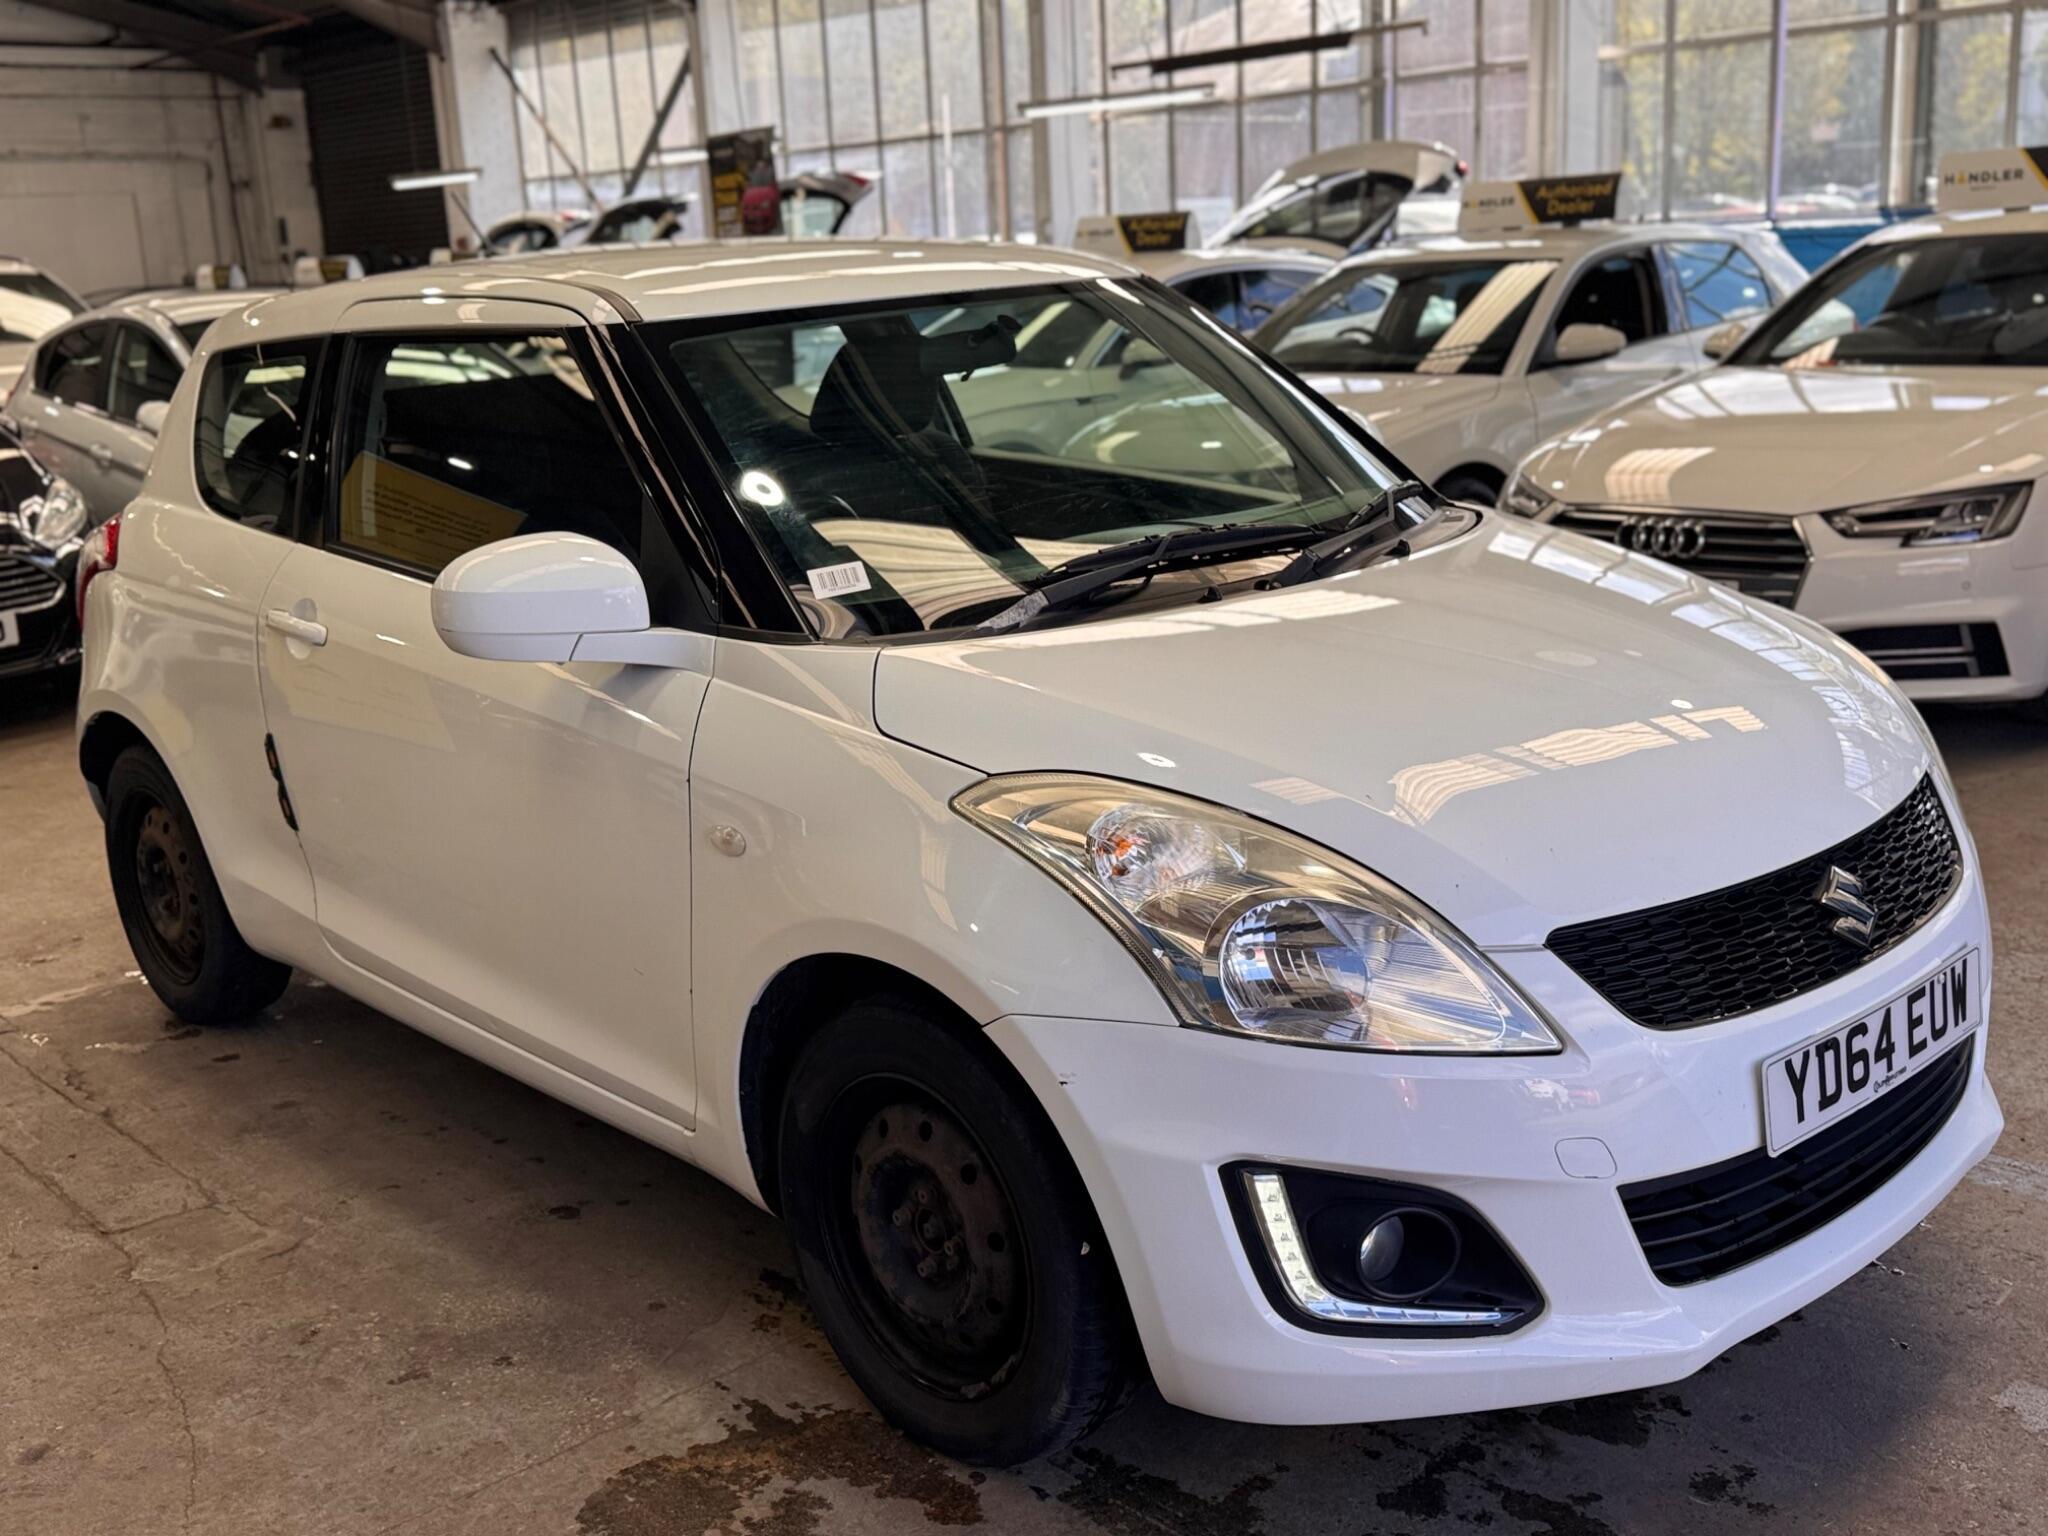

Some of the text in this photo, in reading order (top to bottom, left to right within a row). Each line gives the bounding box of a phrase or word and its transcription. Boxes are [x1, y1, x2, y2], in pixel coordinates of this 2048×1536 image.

[1547, 199, 1594, 215] Dealer
[1784, 958, 1968, 1124] YD64 EUW
